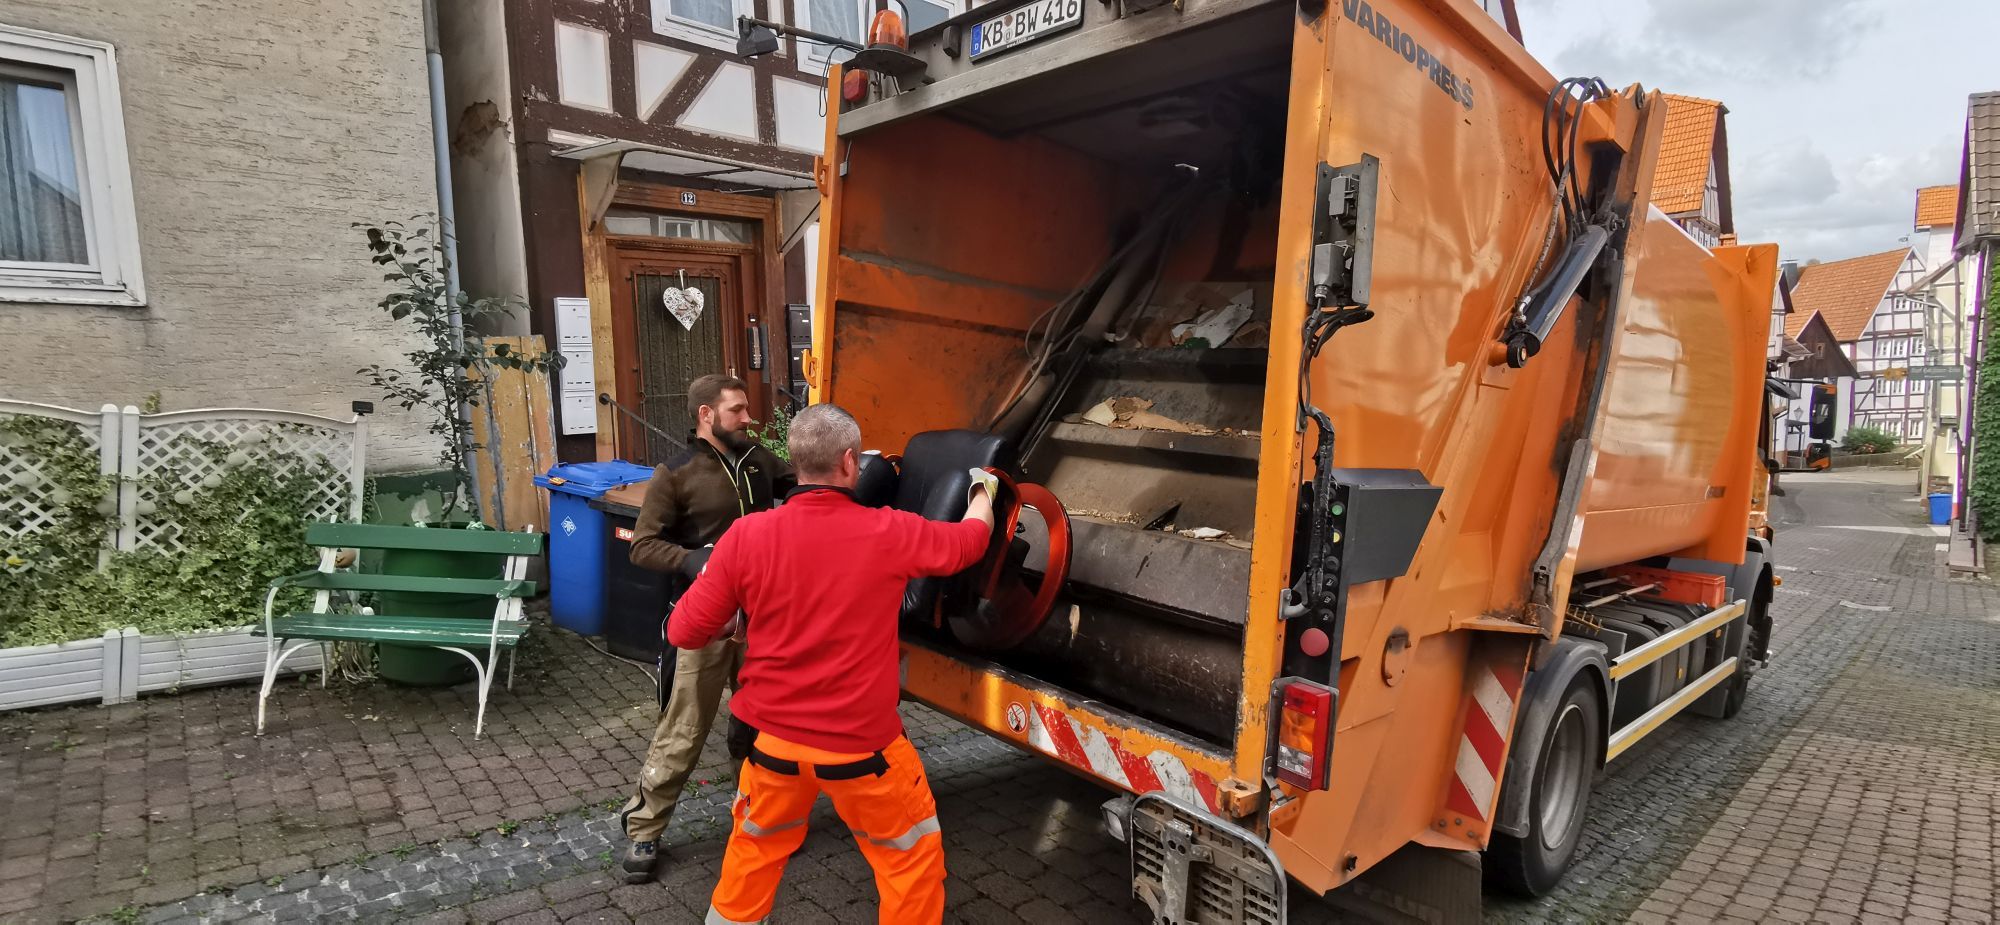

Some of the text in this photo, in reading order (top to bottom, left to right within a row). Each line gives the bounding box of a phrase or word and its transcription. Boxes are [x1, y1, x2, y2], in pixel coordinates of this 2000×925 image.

[974, 43, 979, 51] D
[981, 21, 1004, 50] KB
[1014, 6, 1039, 38] BW
[1042, 0, 1078, 26] 416
[1342, 0, 1474, 111] VARIOPRESS
[683, 193, 694, 204] 12
[619, 529, 634, 539] SU
